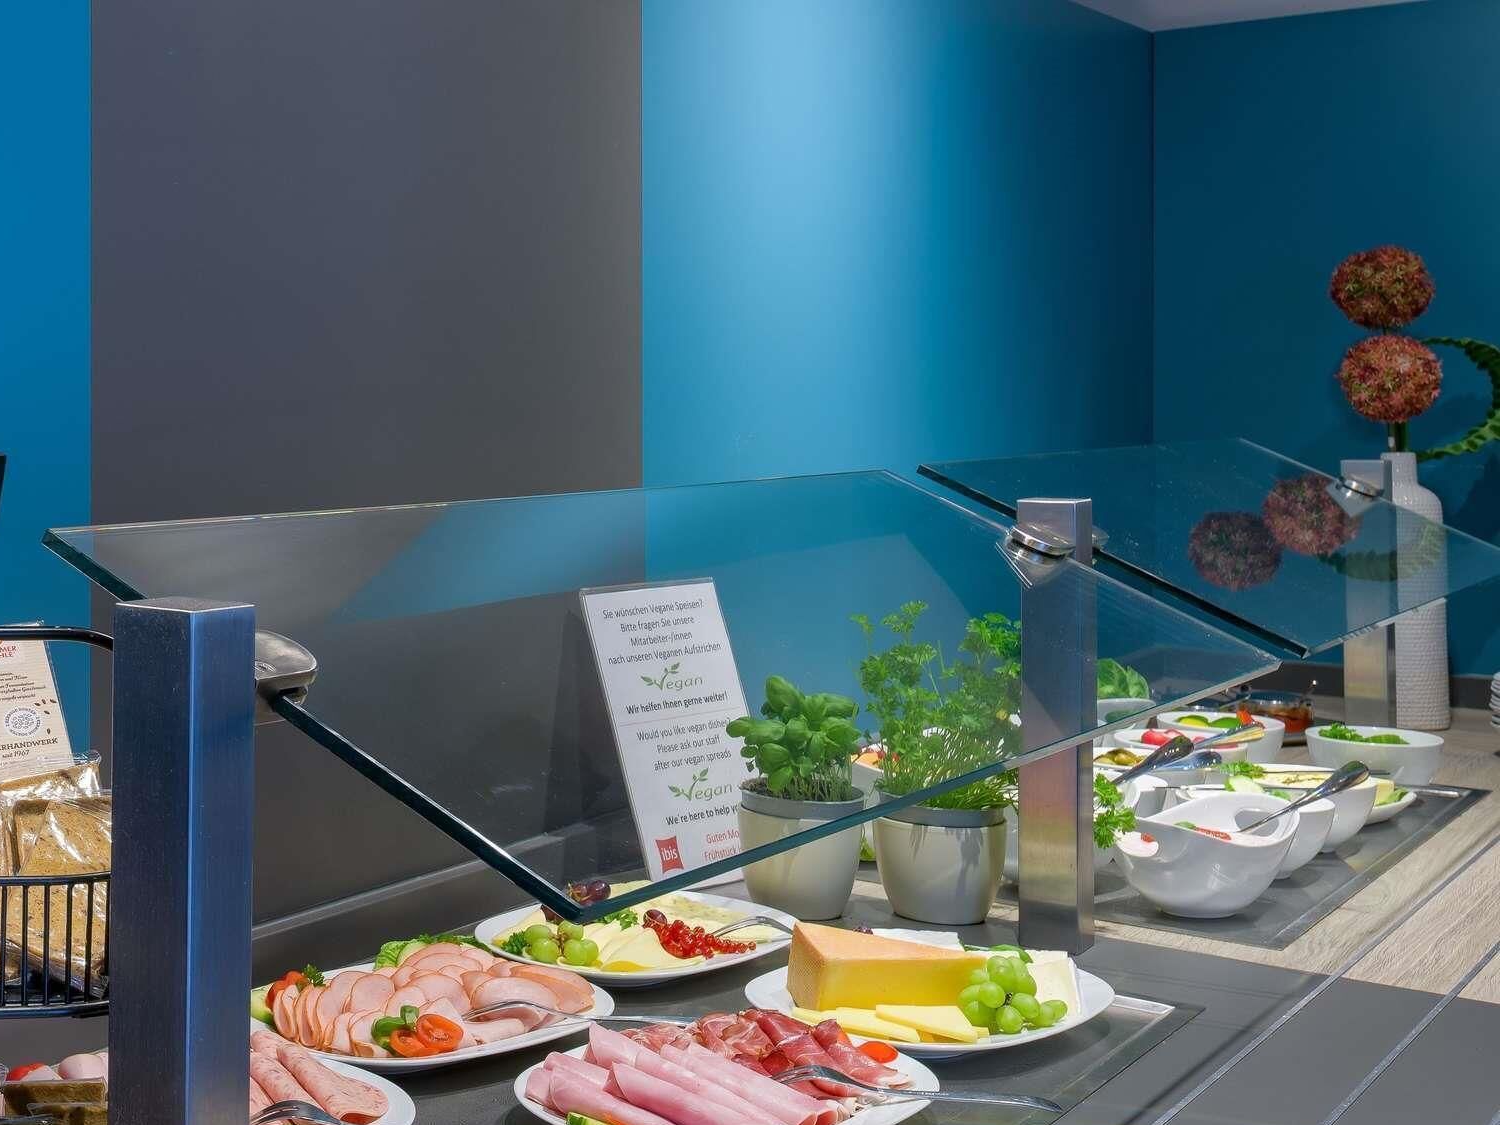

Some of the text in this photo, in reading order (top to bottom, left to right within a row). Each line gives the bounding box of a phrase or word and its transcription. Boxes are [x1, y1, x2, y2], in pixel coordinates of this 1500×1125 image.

[602, 610, 614, 619] Sie
[649, 604, 674, 614] Vegane
[675, 599, 704, 611] Speisen?
[620, 616, 694, 632] Bitte fragen Sie unsere
[608, 642, 722, 665] nach unseren Veganen Aufstrichen
[626, 704, 640, 715] Wir
[662, 698, 682, 710] Ihnen
[683, 697, 702, 708] gerne
[704, 690, 728, 704] weiter!
[636, 729, 660, 740] Would
[660, 729, 672, 740] you
[673, 724, 686, 736] like
[686, 722, 708, 734] vegan
[14, 750, 30, 758] 1967
[656, 734, 721, 754] Please ask our staff
[654, 750, 732, 772] after our vegan spreads
[665, 812, 688, 826] We're
[688, 810, 706, 821] here
[706, 808, 714, 818] to
[714, 804, 730, 816] help
[727, 829, 740, 840] Mo
[660, 844, 678, 860] ibis
